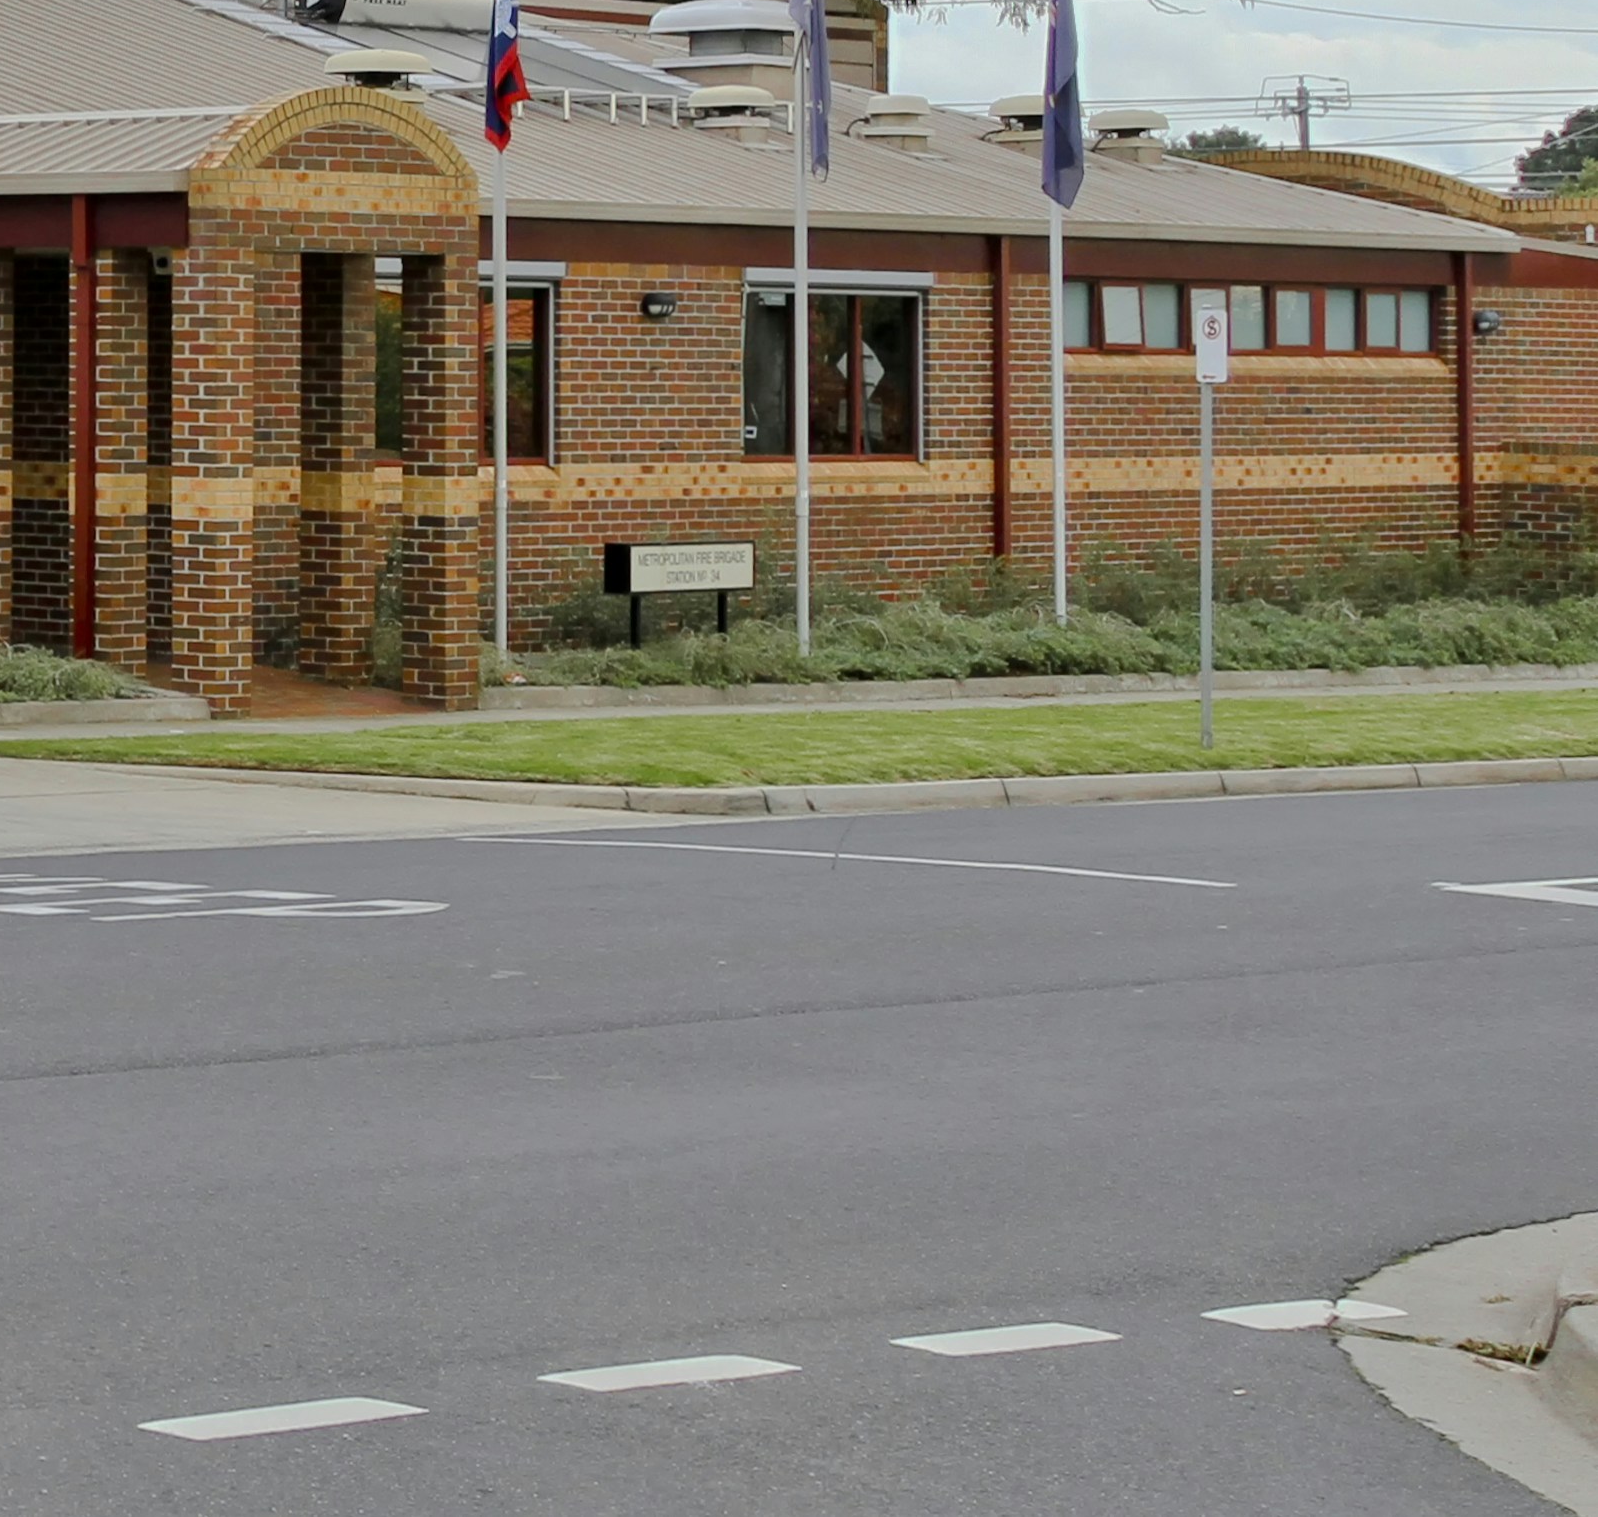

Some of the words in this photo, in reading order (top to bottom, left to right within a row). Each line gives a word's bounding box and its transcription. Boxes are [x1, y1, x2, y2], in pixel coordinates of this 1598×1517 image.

[638, 551, 694, 567] METROPOLITAN
[696, 551, 712, 564] FIRE
[714, 550, 746, 563] BRIGADE
[666, 569, 695, 584] STATION
